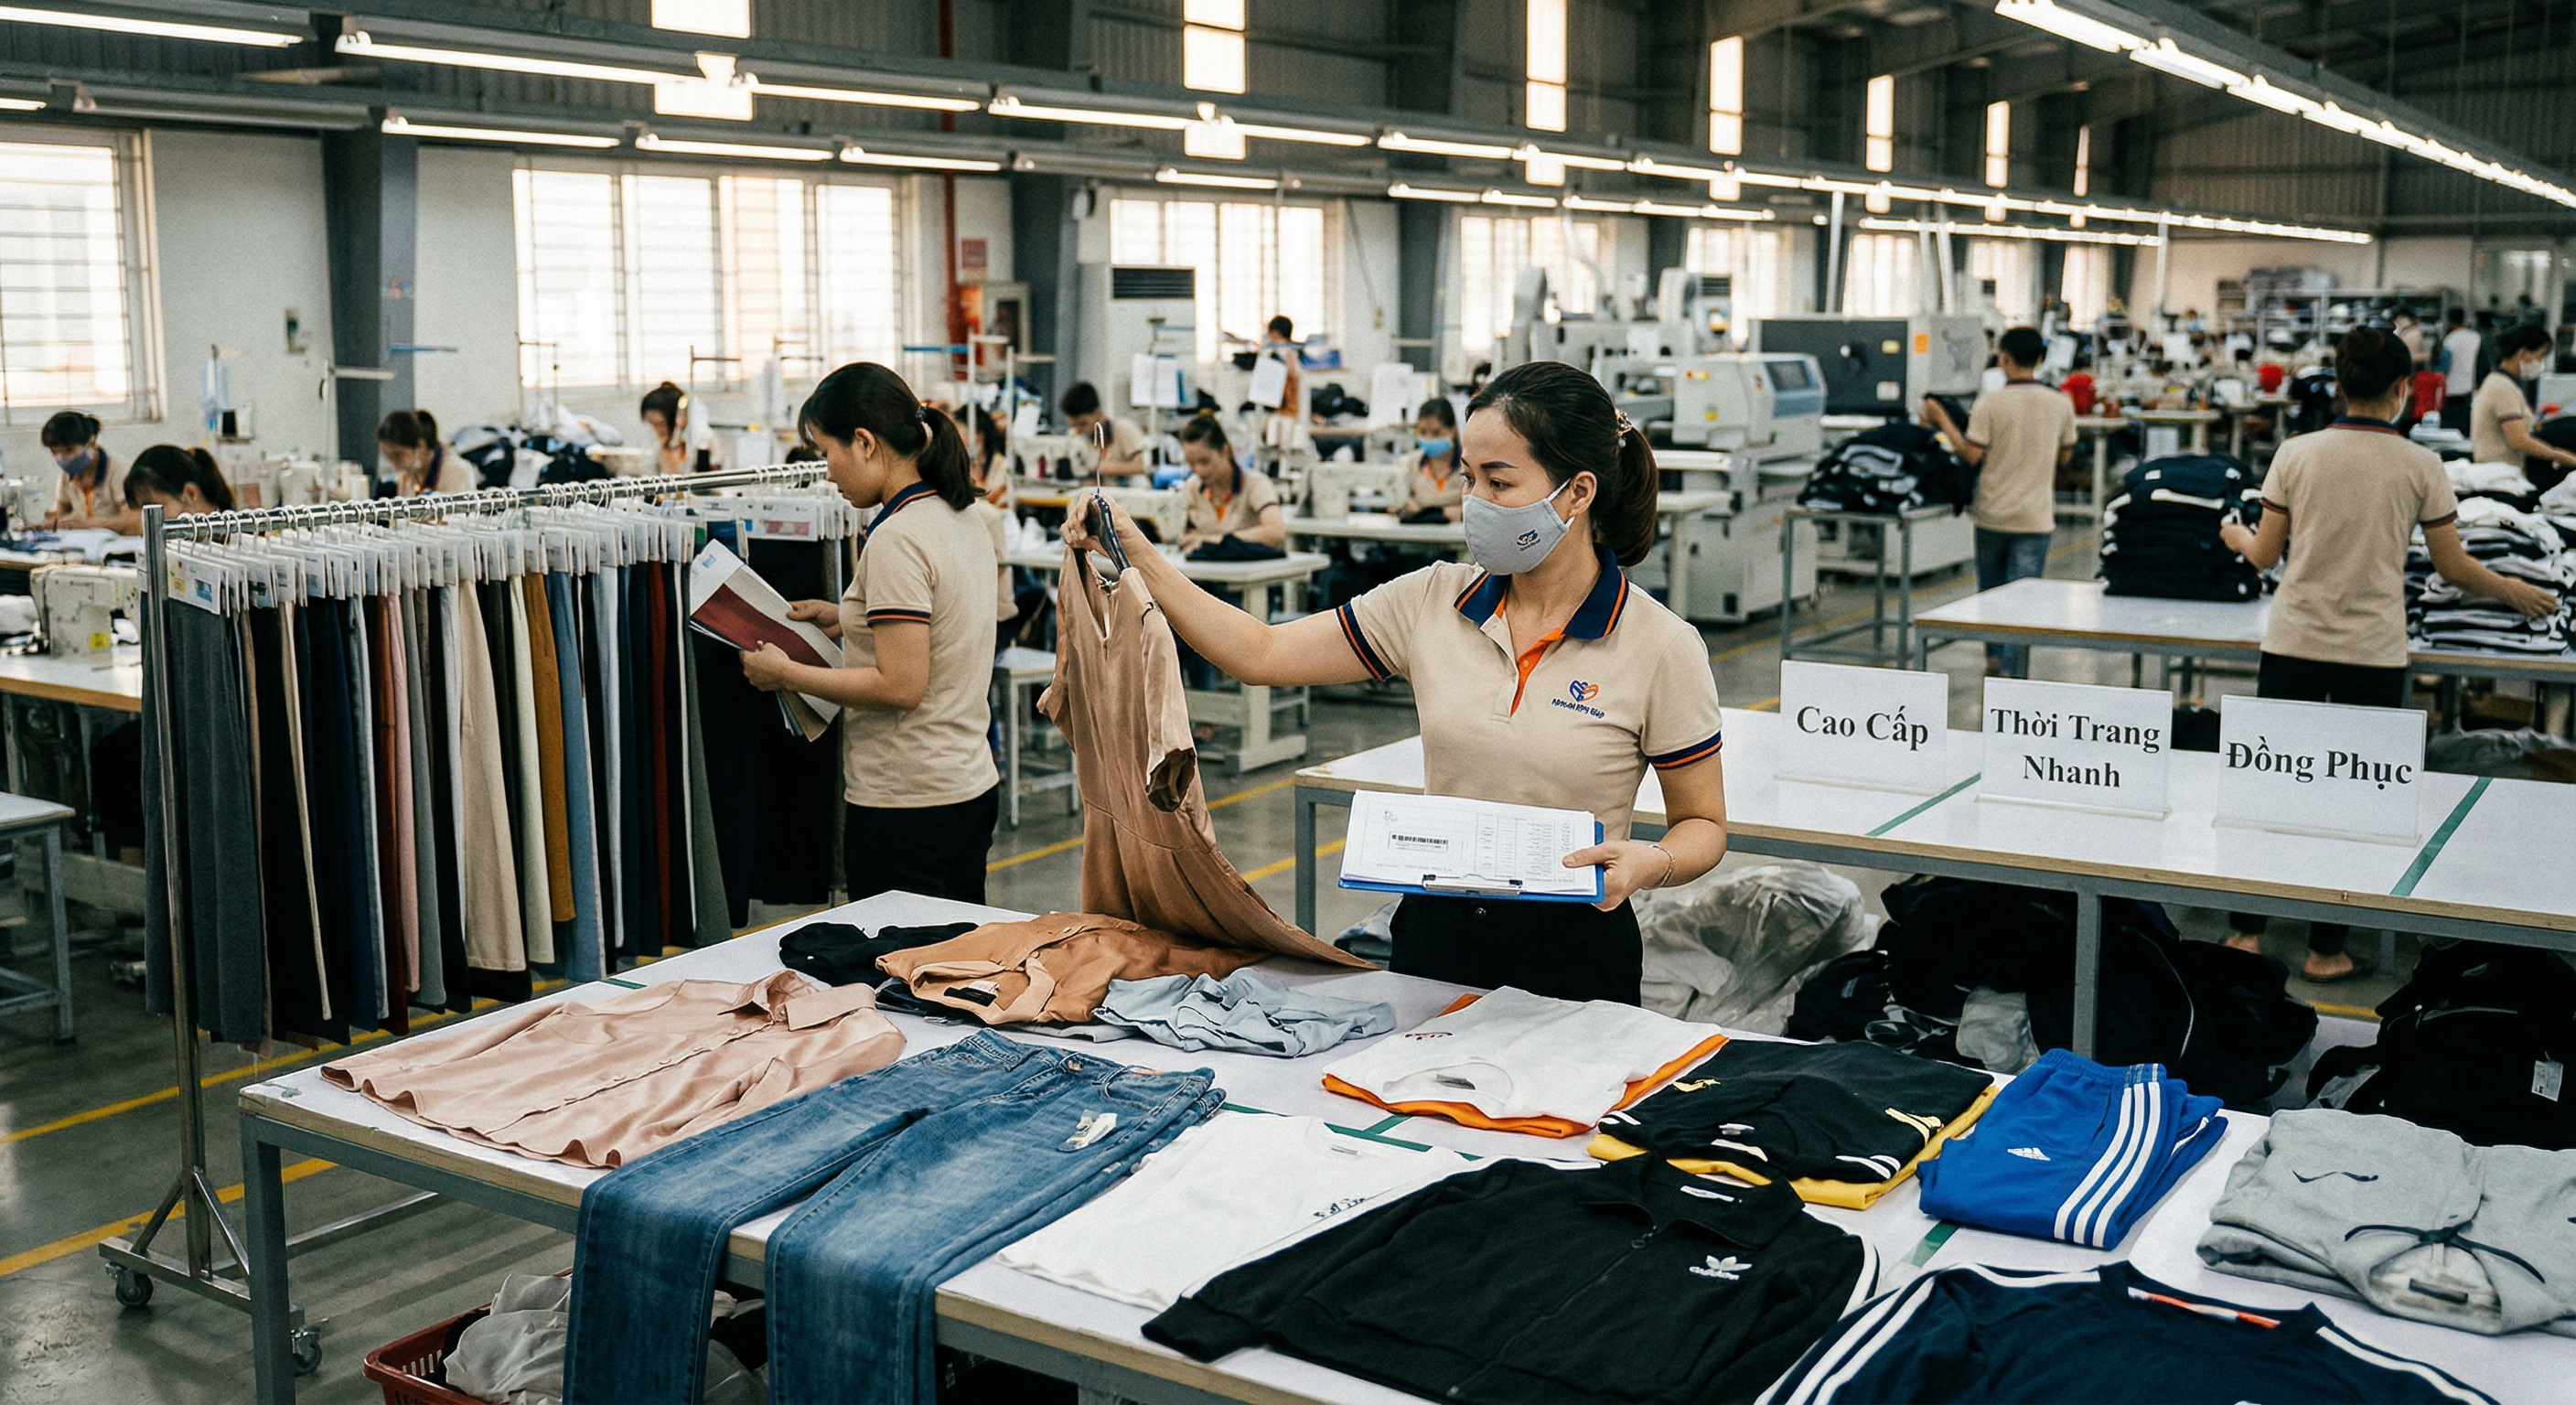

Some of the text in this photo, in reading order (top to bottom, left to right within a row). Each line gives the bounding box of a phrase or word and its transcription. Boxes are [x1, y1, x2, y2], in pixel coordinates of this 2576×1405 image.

[1797, 705, 1928, 751] Cao Cấp
[1991, 708, 2161, 754] Thời Trang
[2023, 755, 2120, 788] Nhanh
[2226, 735, 2412, 790] Đồng Phục
